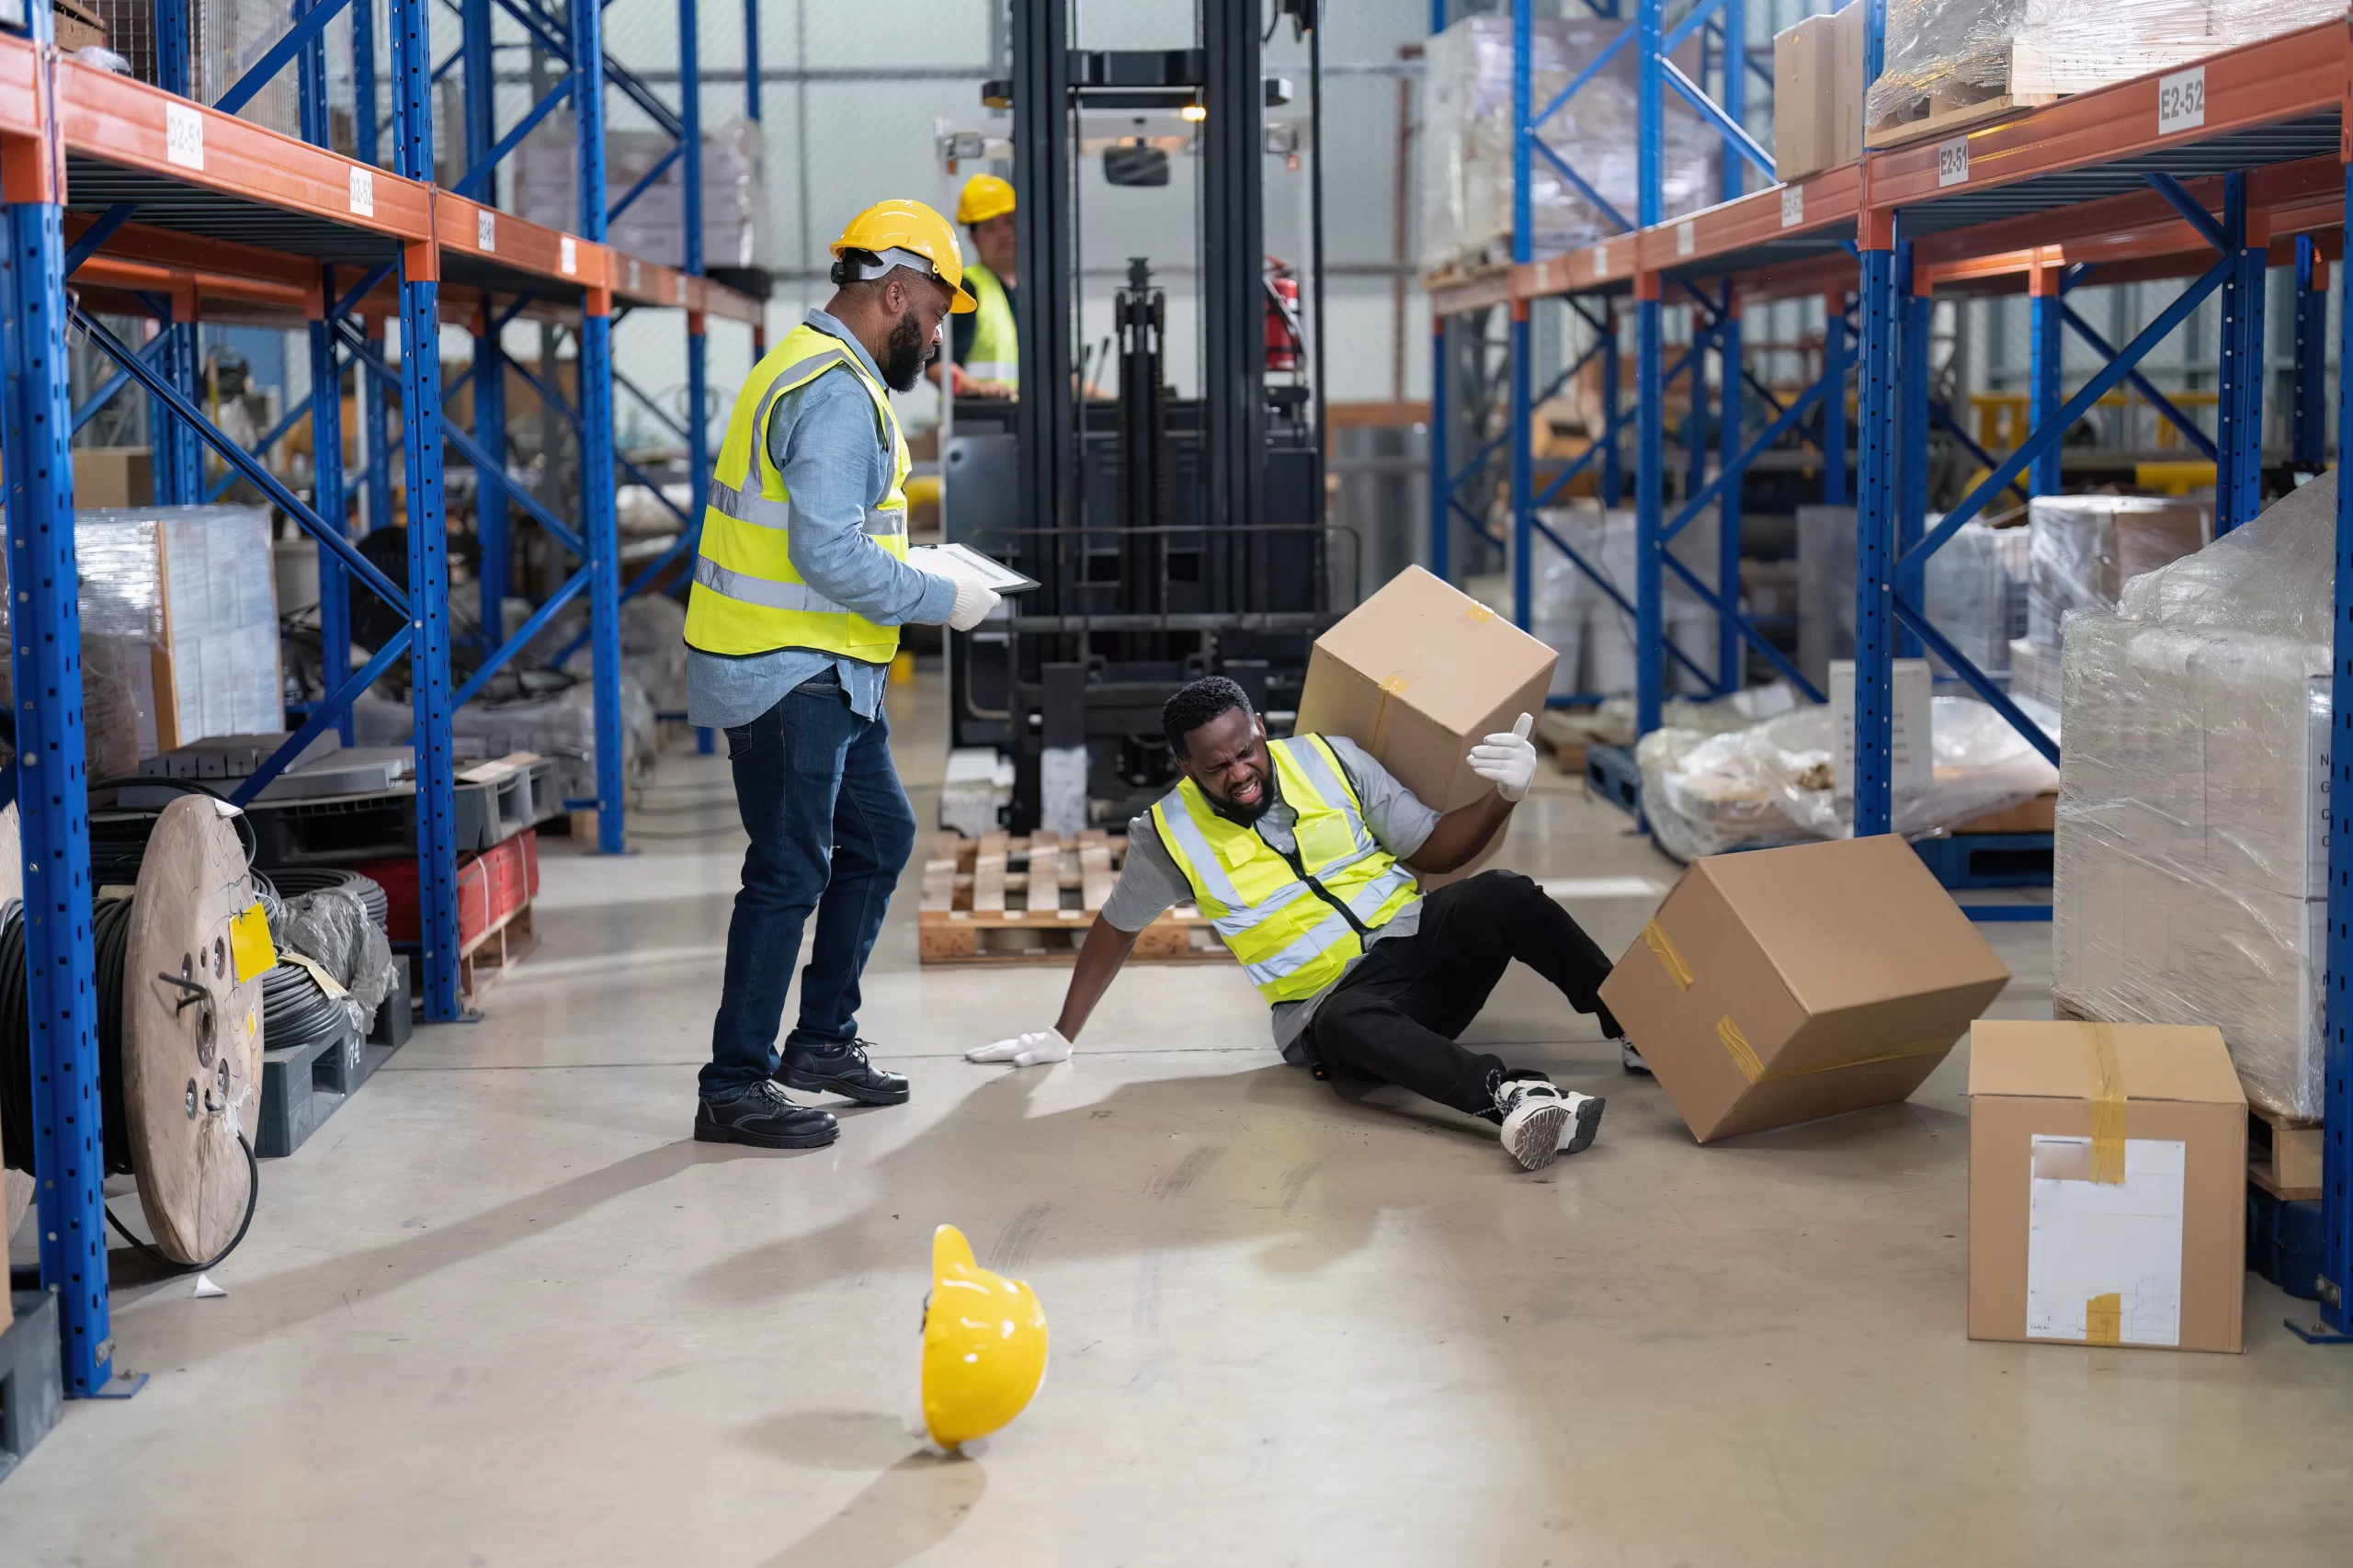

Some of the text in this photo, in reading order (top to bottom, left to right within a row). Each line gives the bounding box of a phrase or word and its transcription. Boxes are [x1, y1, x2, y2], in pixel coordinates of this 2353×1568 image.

[2161, 79, 2203, 120] E2-52
[168, 116, 201, 155] D2-51
[1940, 144, 1967, 176] E2-51
[350, 176, 372, 207] D2-52
